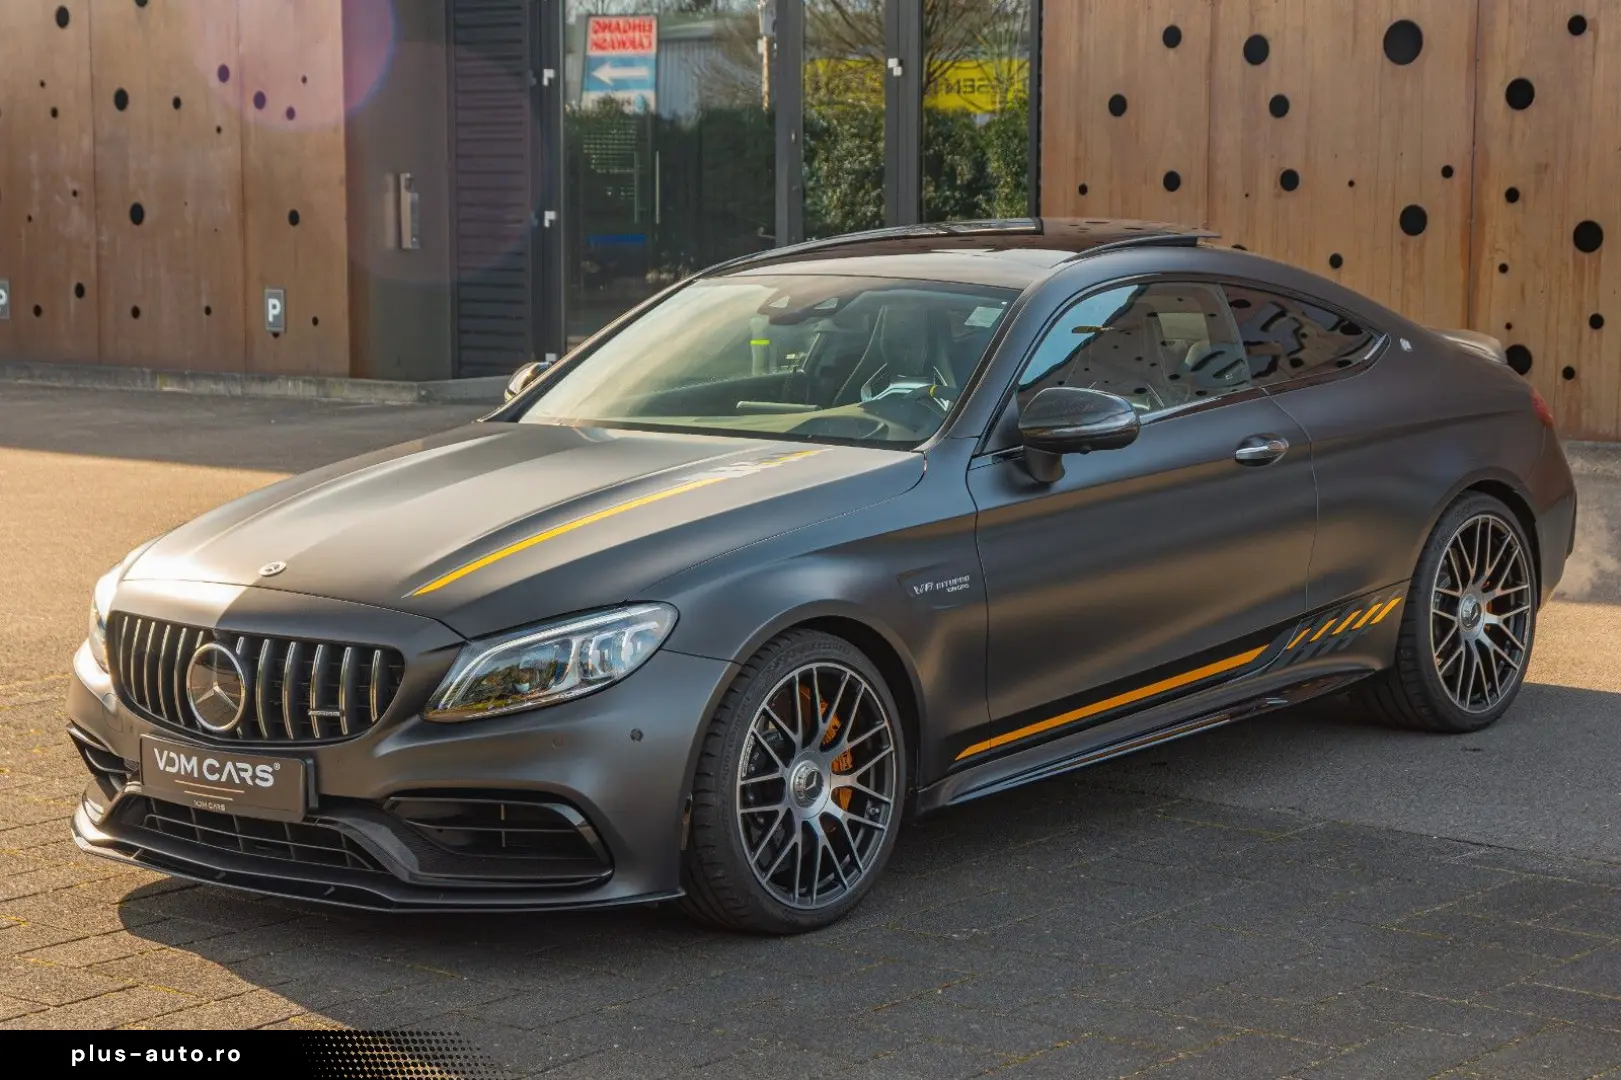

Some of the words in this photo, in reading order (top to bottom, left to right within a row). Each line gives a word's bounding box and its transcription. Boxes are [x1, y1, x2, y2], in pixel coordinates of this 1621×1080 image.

[267, 298, 282, 322] P
[153, 747, 199, 778] VDM
[207, 801, 226, 812] CARS
